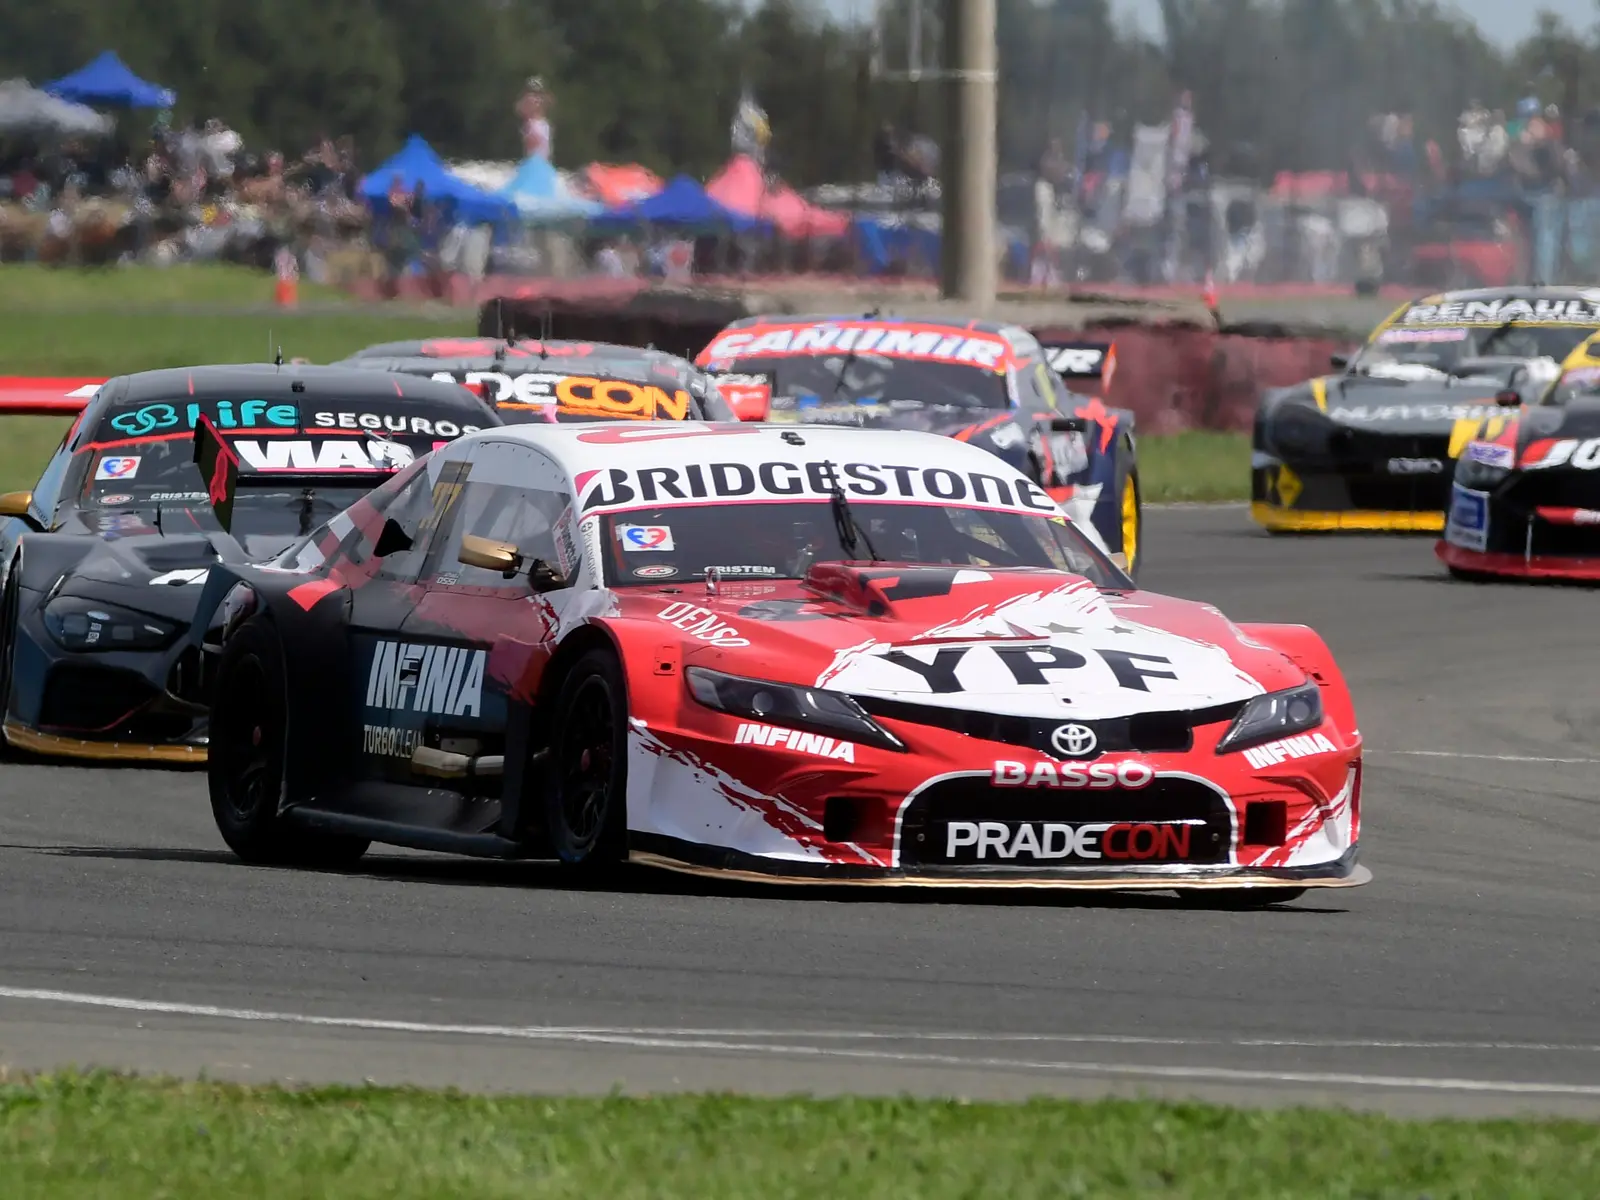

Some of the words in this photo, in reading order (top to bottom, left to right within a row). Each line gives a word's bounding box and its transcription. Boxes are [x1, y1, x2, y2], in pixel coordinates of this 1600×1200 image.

[582, 462, 1055, 511] BRIDGESTONE
[704, 565, 776, 574] CRISTEM
[657, 601, 750, 648] DENSO
[366, 640, 487, 718] INFINIA
[873, 645, 1178, 693] YPF
[734, 723, 855, 763] INFINIA
[1241, 732, 1338, 770] INFINIA
[994, 760, 1155, 789] BASSO
[945, 821, 1192, 860] PRADECON
